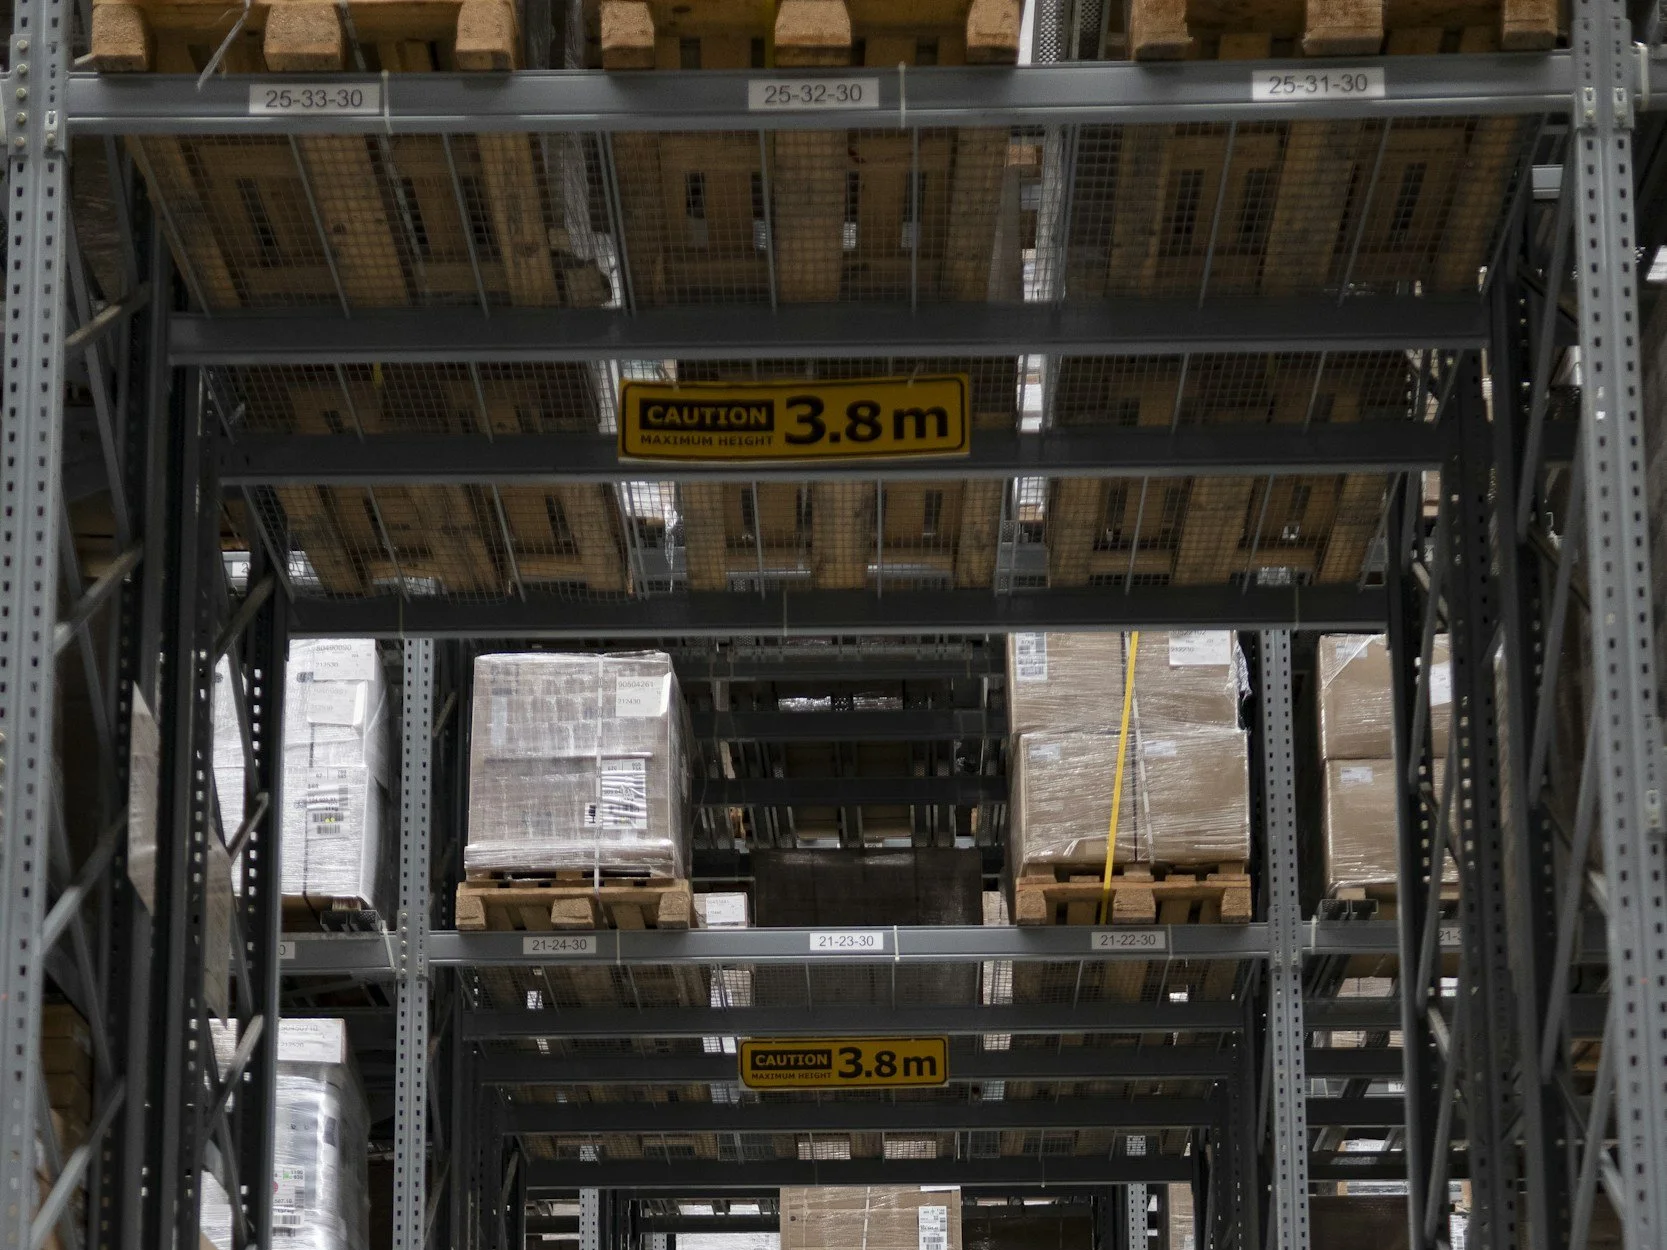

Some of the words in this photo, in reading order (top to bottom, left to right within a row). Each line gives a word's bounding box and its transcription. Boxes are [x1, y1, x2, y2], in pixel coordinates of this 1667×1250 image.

[1268, 74, 1368, 96] 25-31-30
[264, 88, 364, 110] 25-33-30
[763, 83, 863, 106] 25-32-30
[646, 405, 768, 426] CAUTION
[640, 434, 713, 446] MAXIMUM
[718, 434, 774, 447] HEIGHT
[532, 939, 587, 951] 21-24-30
[818, 935, 875, 947] 21-23-30
[1100, 934, 1156, 946] 21-22-30
[755, 1054, 828, 1066] CAUTION
[751, 1072, 796, 1080] MAXIMUM
[798, 1071, 832, 1079] HEIGHT
